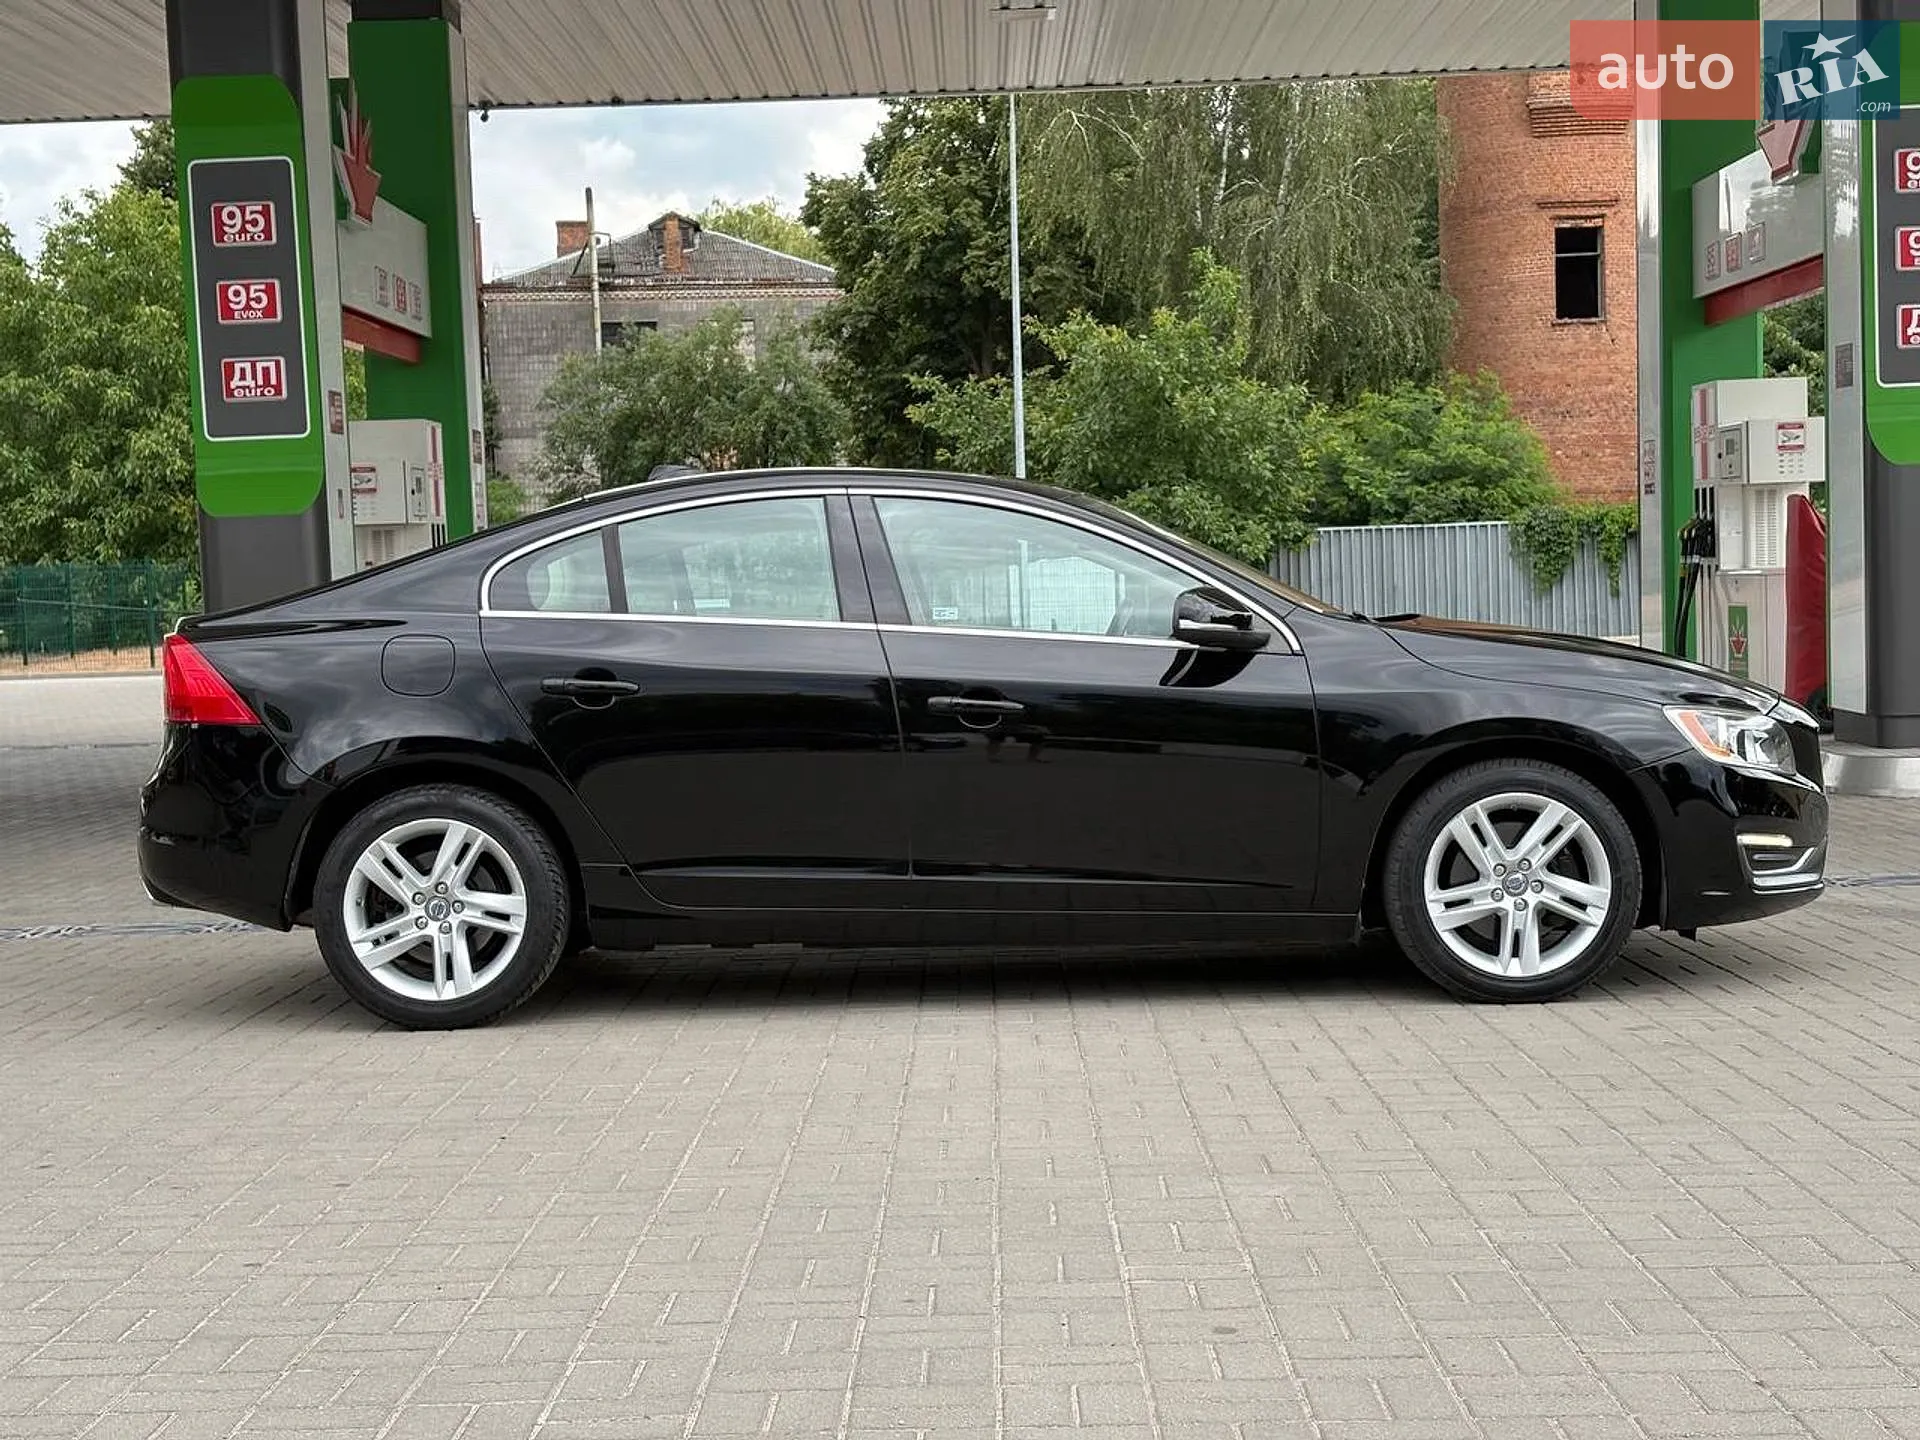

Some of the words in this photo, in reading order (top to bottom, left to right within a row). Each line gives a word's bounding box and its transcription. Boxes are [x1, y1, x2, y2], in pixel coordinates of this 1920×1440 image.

[1906, 151, 1920, 180] 9
[221, 205, 265, 234] 95
[223, 231, 265, 242] euro
[227, 284, 268, 310] 95
[234, 310, 264, 319] EVOX
[230, 361, 277, 389] ДП
[234, 386, 276, 398] euro
